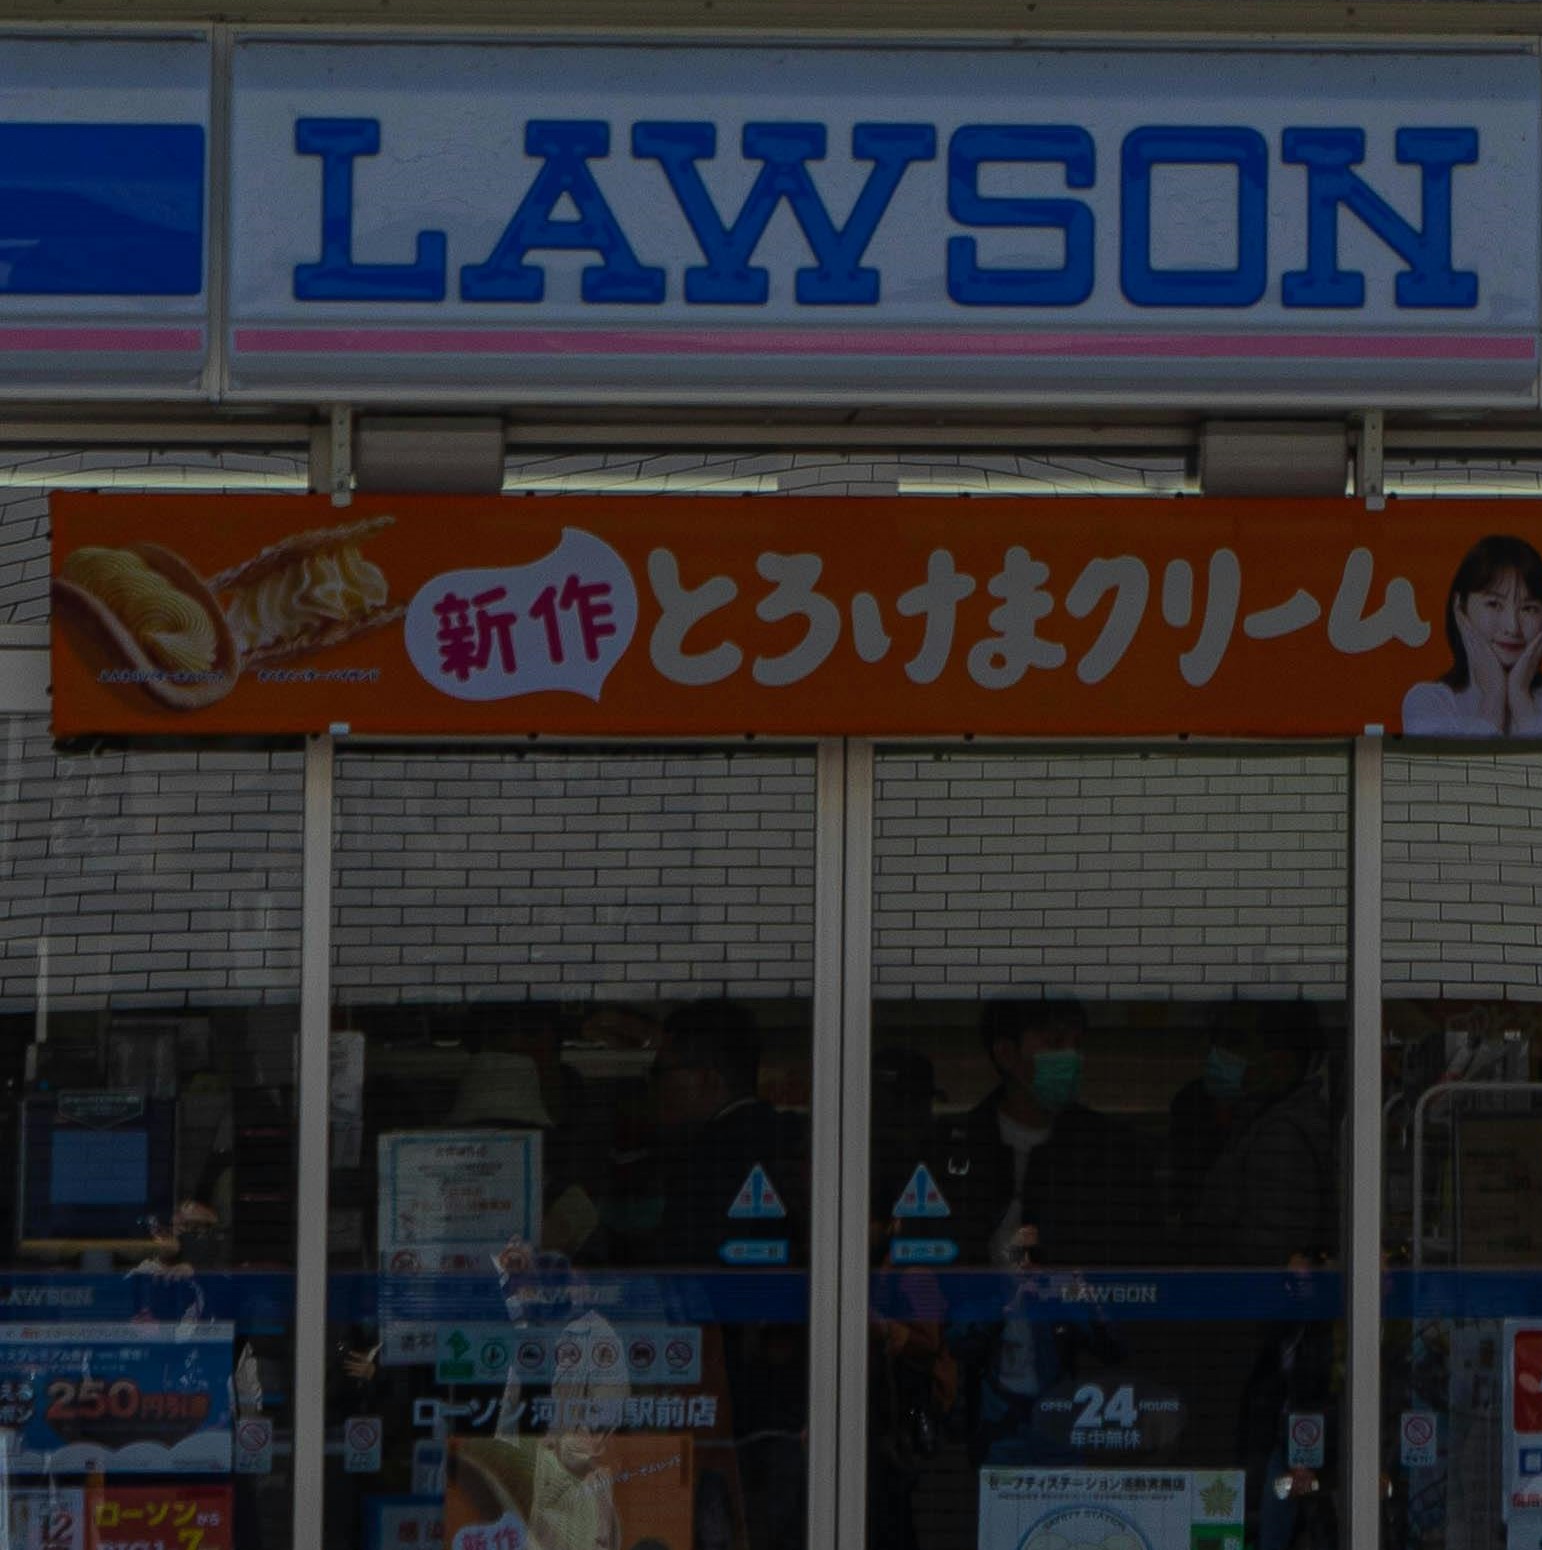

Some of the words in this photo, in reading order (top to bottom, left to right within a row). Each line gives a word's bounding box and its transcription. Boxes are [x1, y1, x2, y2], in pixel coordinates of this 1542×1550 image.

[294, 117, 1480, 307] LAWSON
[434, 573, 617, 681] 新作
[647, 544, 1433, 689] とろけまクリーム
[3, 1285, 96, 1307] AWSON
[1060, 1283, 1158, 1303] LAWSON
[1039, 1400, 1073, 1413] OPEN
[1072, 1383, 1139, 1429] 24
[1138, 1399, 1181, 1413] HOURS
[1069, 1429, 1142, 1450] 年中無休
